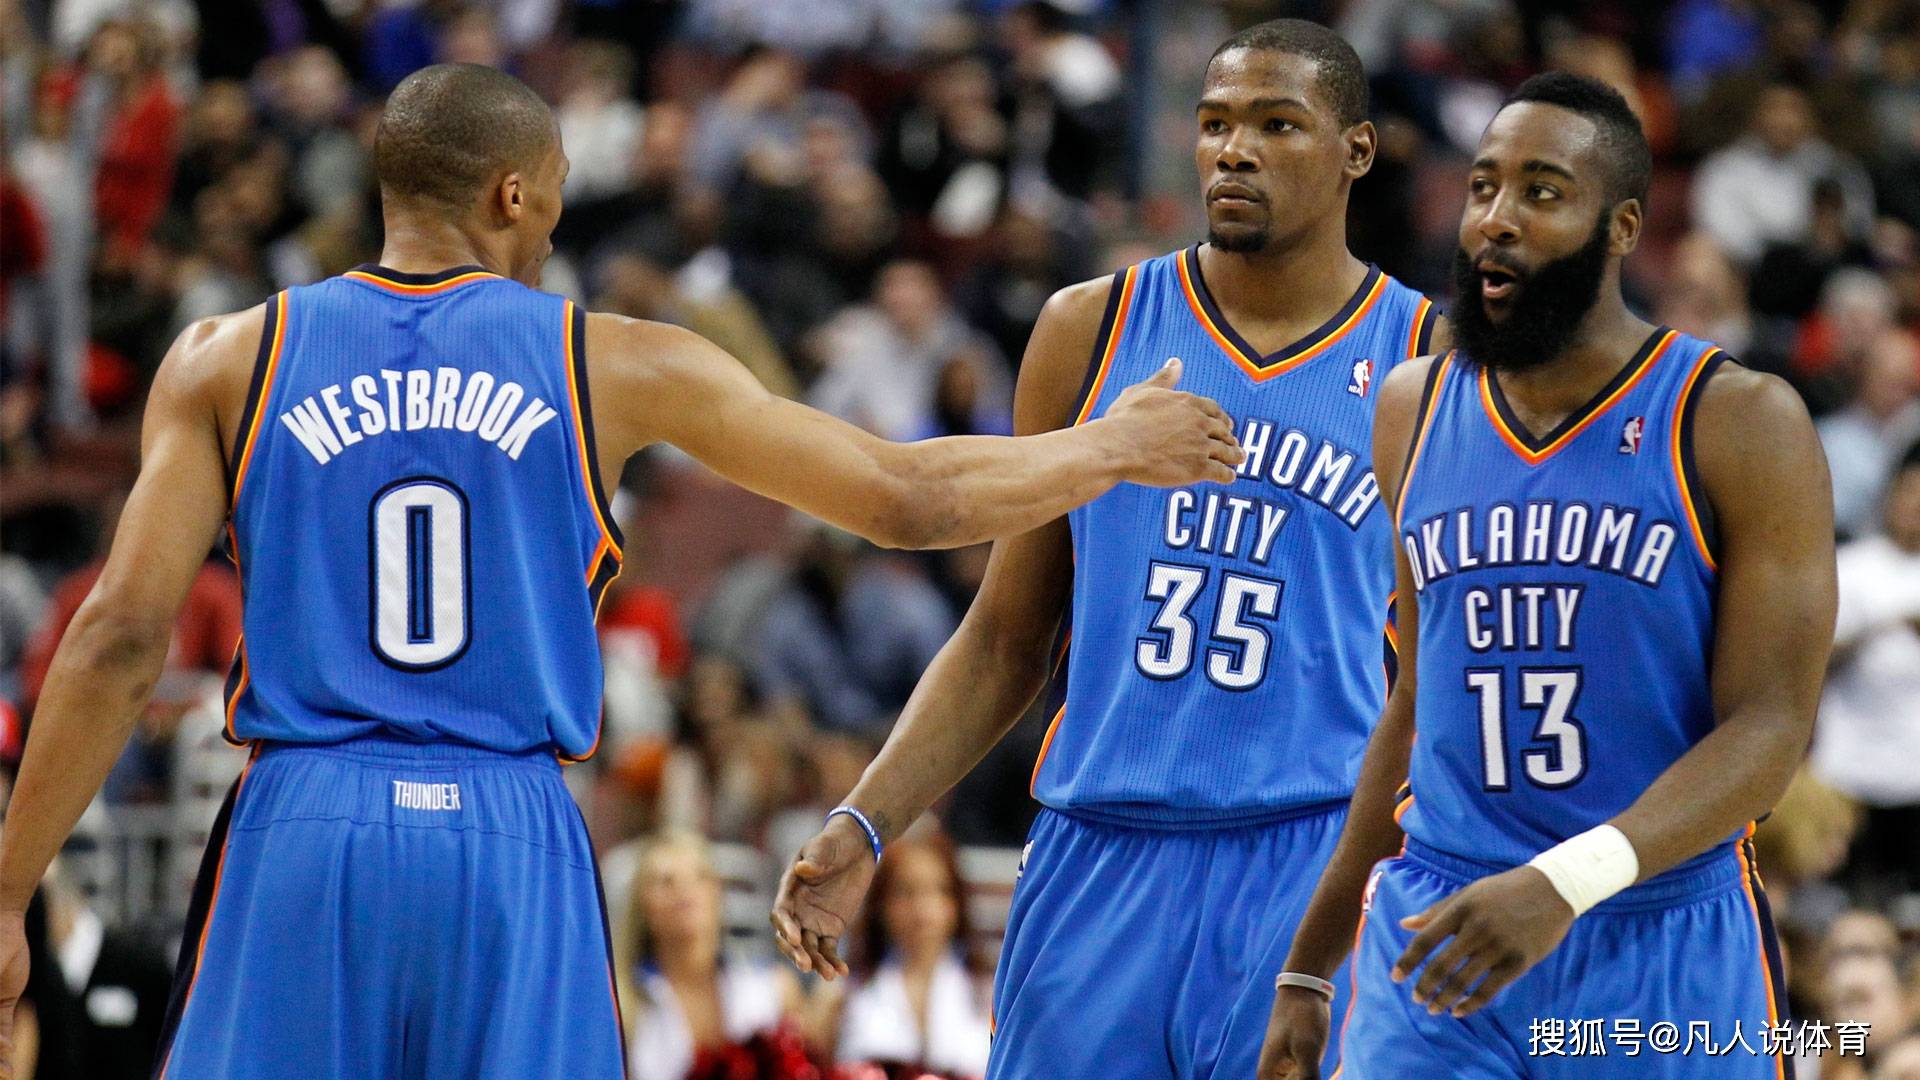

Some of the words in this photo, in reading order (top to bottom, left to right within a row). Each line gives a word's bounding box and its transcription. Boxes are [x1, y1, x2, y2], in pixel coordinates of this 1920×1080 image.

[281, 367, 557, 465] WESTBROOK
[1236, 417, 1381, 531] HOMA
[370, 477, 471, 672] 0
[1165, 488, 1290, 564] CITY
[1404, 501, 1678, 593] OKLAHOMA
[1135, 561, 1284, 690] 35
[1465, 584, 1584, 652] CITY
[1465, 667, 1587, 792] 13
[393, 780, 461, 809] THUNDER
